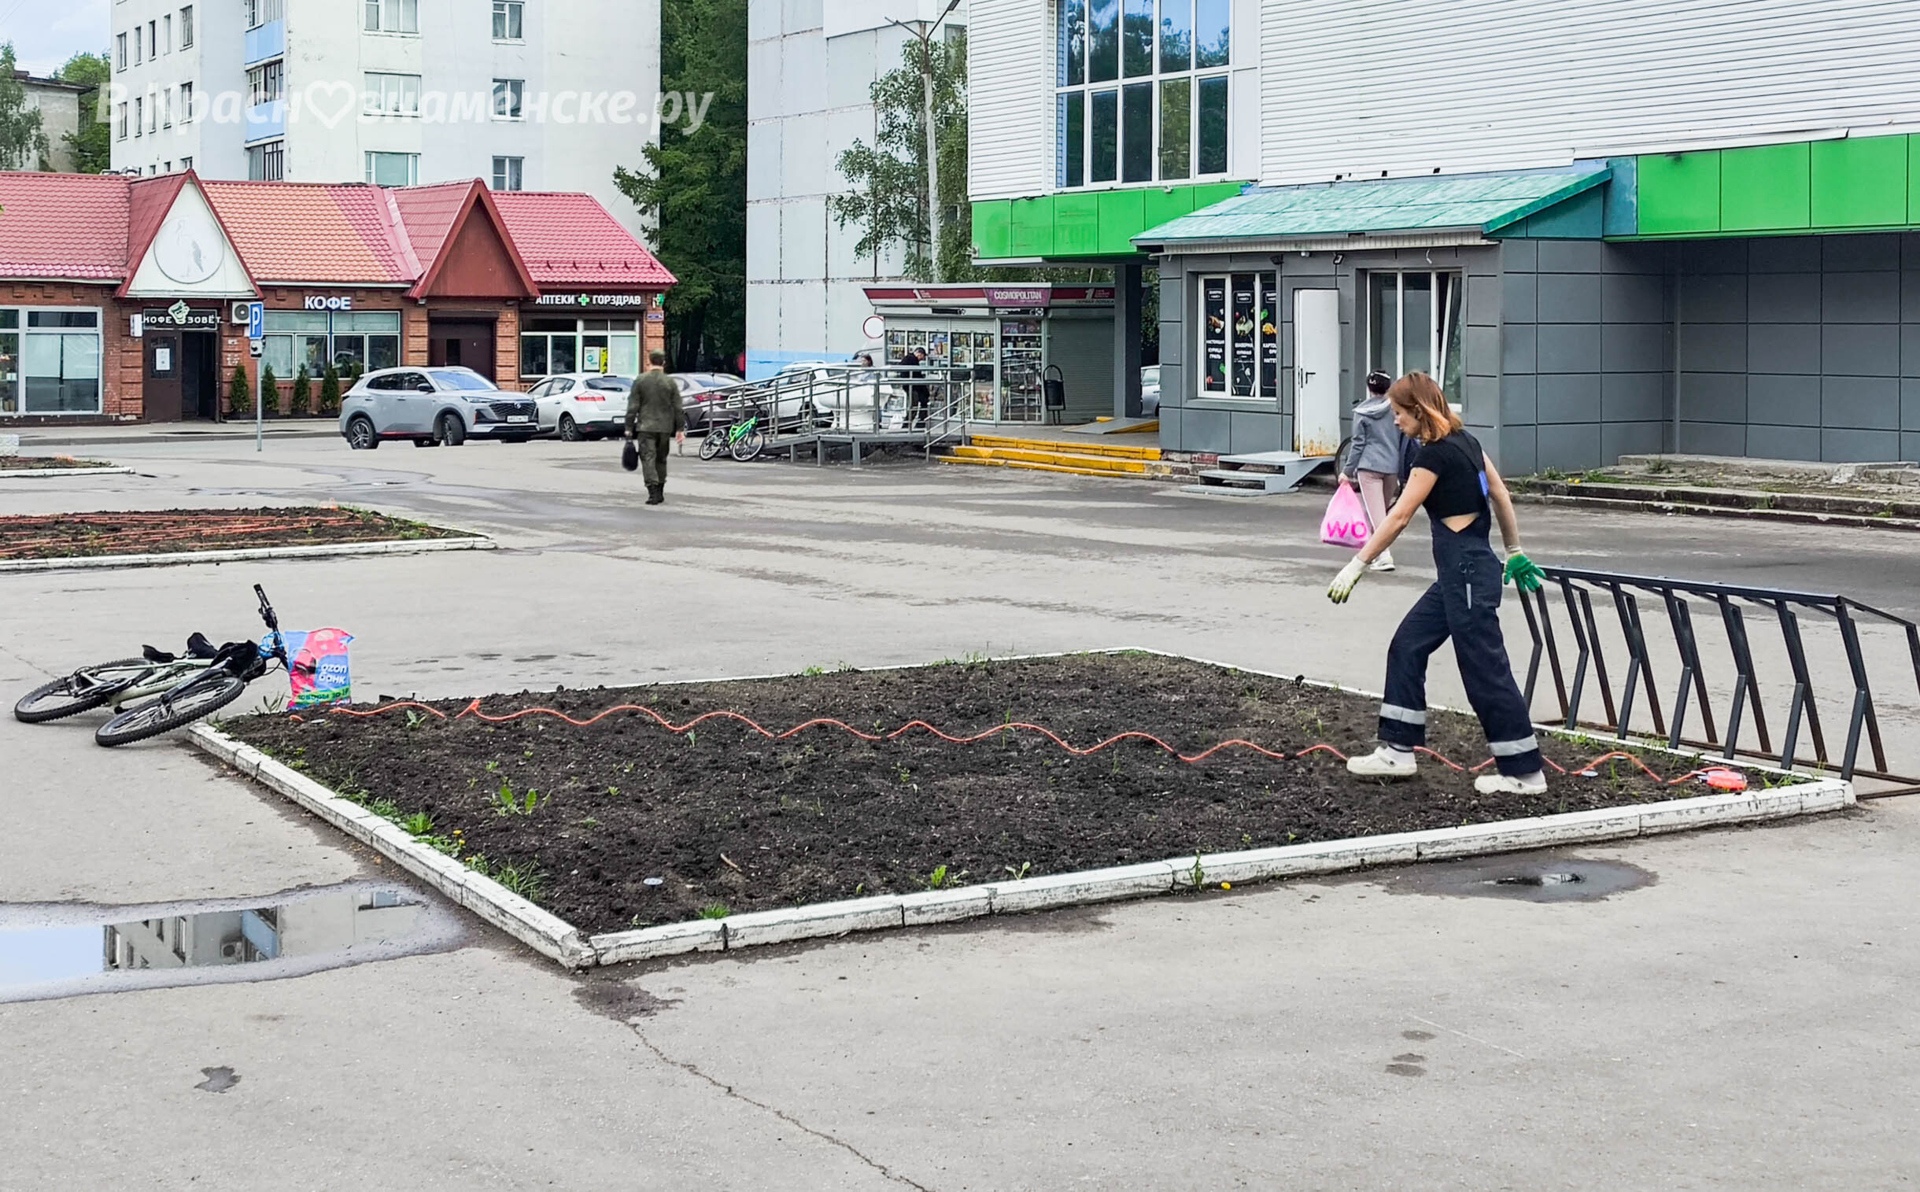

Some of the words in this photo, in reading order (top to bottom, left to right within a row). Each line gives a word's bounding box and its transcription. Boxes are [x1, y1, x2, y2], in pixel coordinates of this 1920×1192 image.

[535, 295, 575, 305] АПТЕКИ
[592, 294, 642, 306] ГОРЗДРАВ
[994, 291, 1042, 301] COSMOPOLITAN
[304, 296, 352, 310] КОФЕ
[143, 316, 173, 324] КОФЕ
[321, 664, 347, 673] ozon
[319, 671, 346, 684] банк
